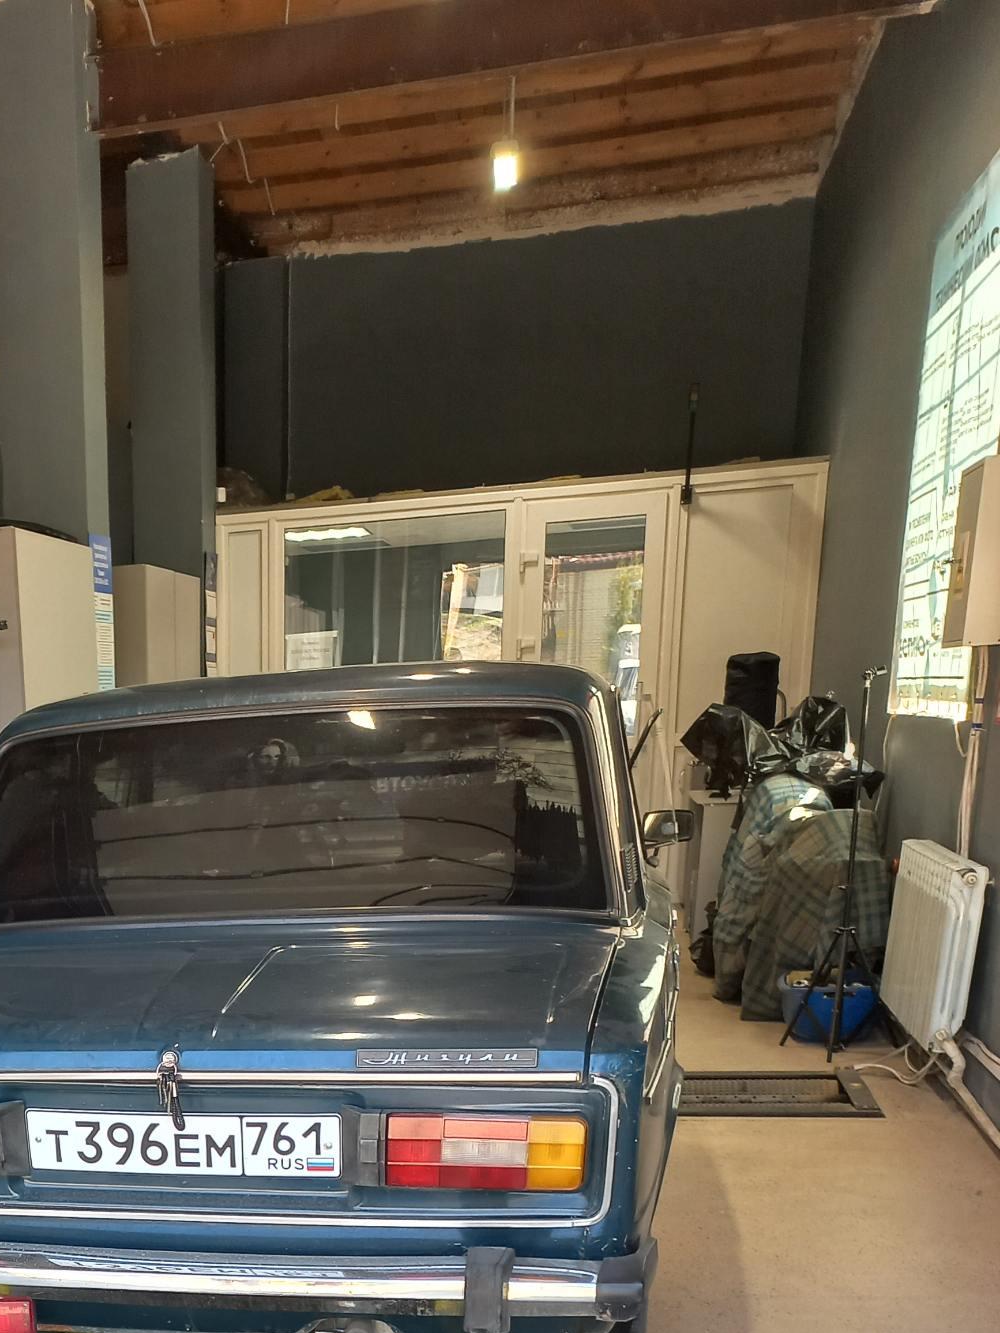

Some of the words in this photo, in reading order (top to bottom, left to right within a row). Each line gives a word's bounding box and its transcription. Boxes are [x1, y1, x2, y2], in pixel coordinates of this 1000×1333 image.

[362, 1051, 531, 1065] Жигули
[245, 1121, 322, 1156] 761
[267, 1157, 305, 1171] RUS
